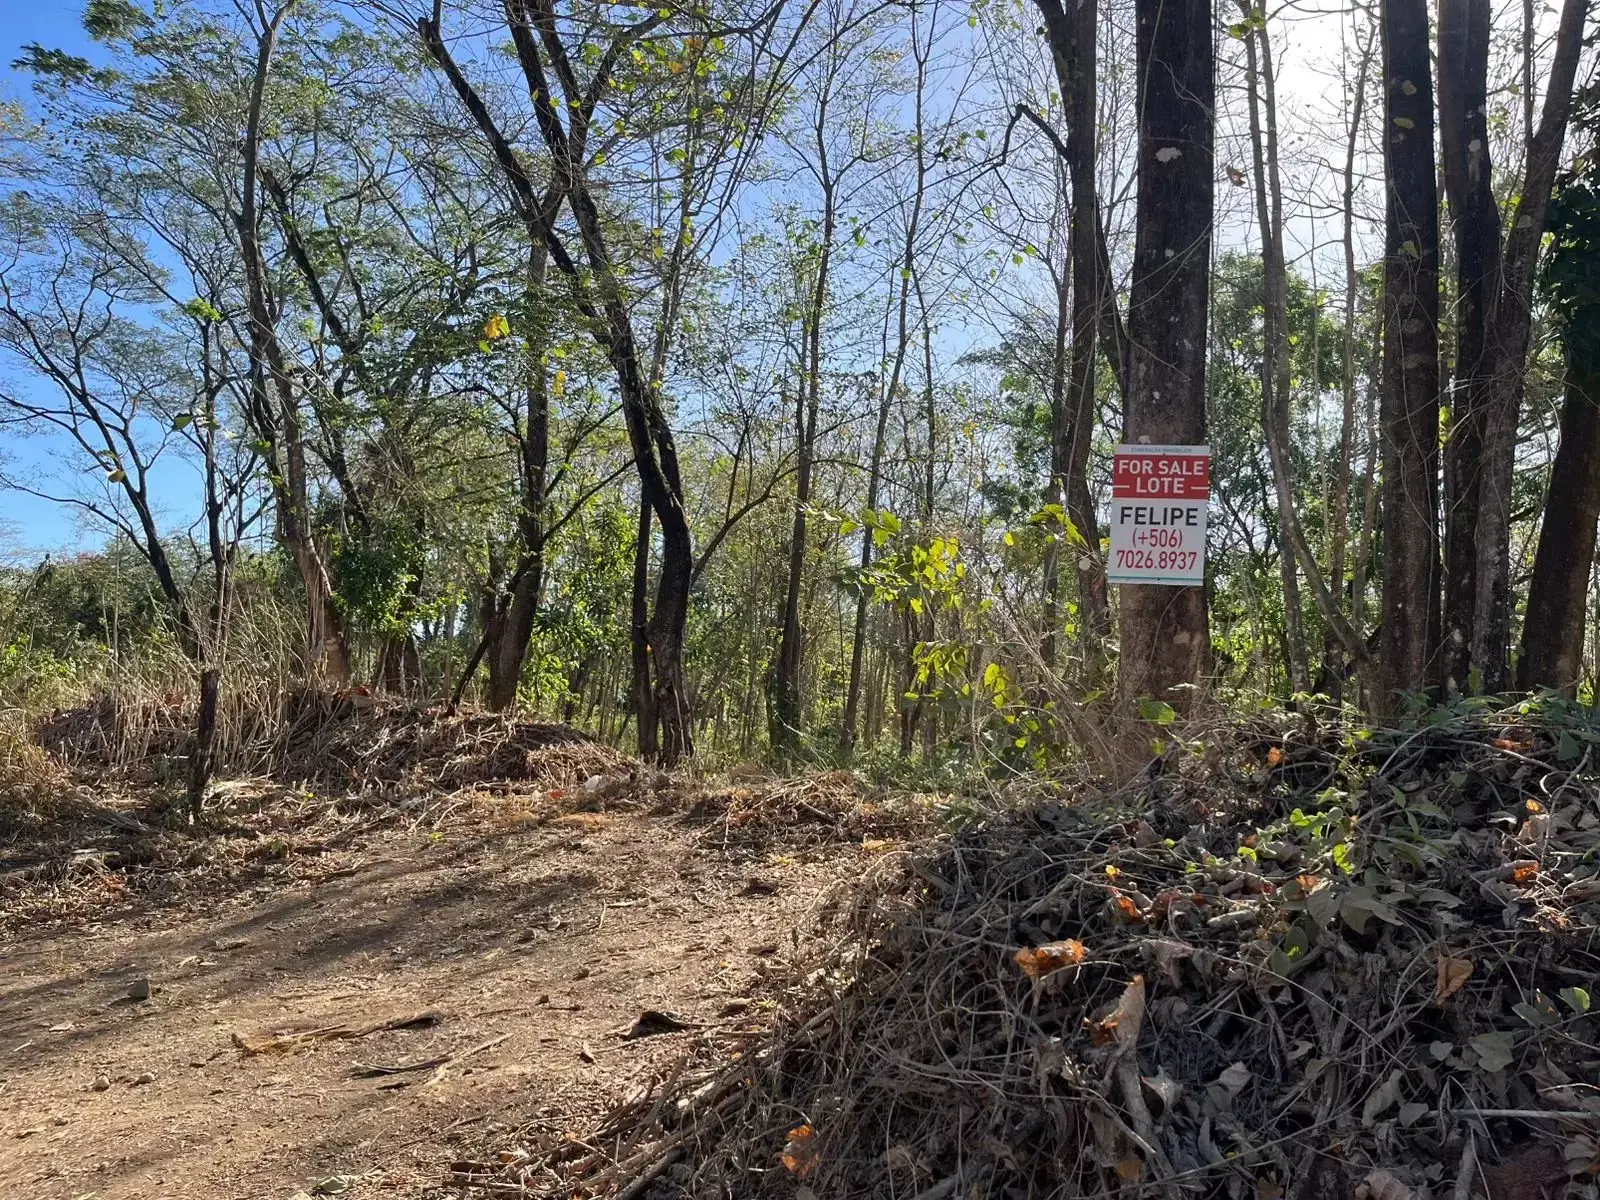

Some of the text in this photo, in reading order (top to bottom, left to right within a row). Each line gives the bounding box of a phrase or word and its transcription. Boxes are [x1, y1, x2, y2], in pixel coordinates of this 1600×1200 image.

[1118, 460, 1204, 475] FOR SALE
[1136, 477, 1185, 493] LOTE
[1120, 507, 1198, 526] FELIPE
[1132, 528, 1182, 548] (+506)
[1116, 550, 1197, 570] 7026.8937
